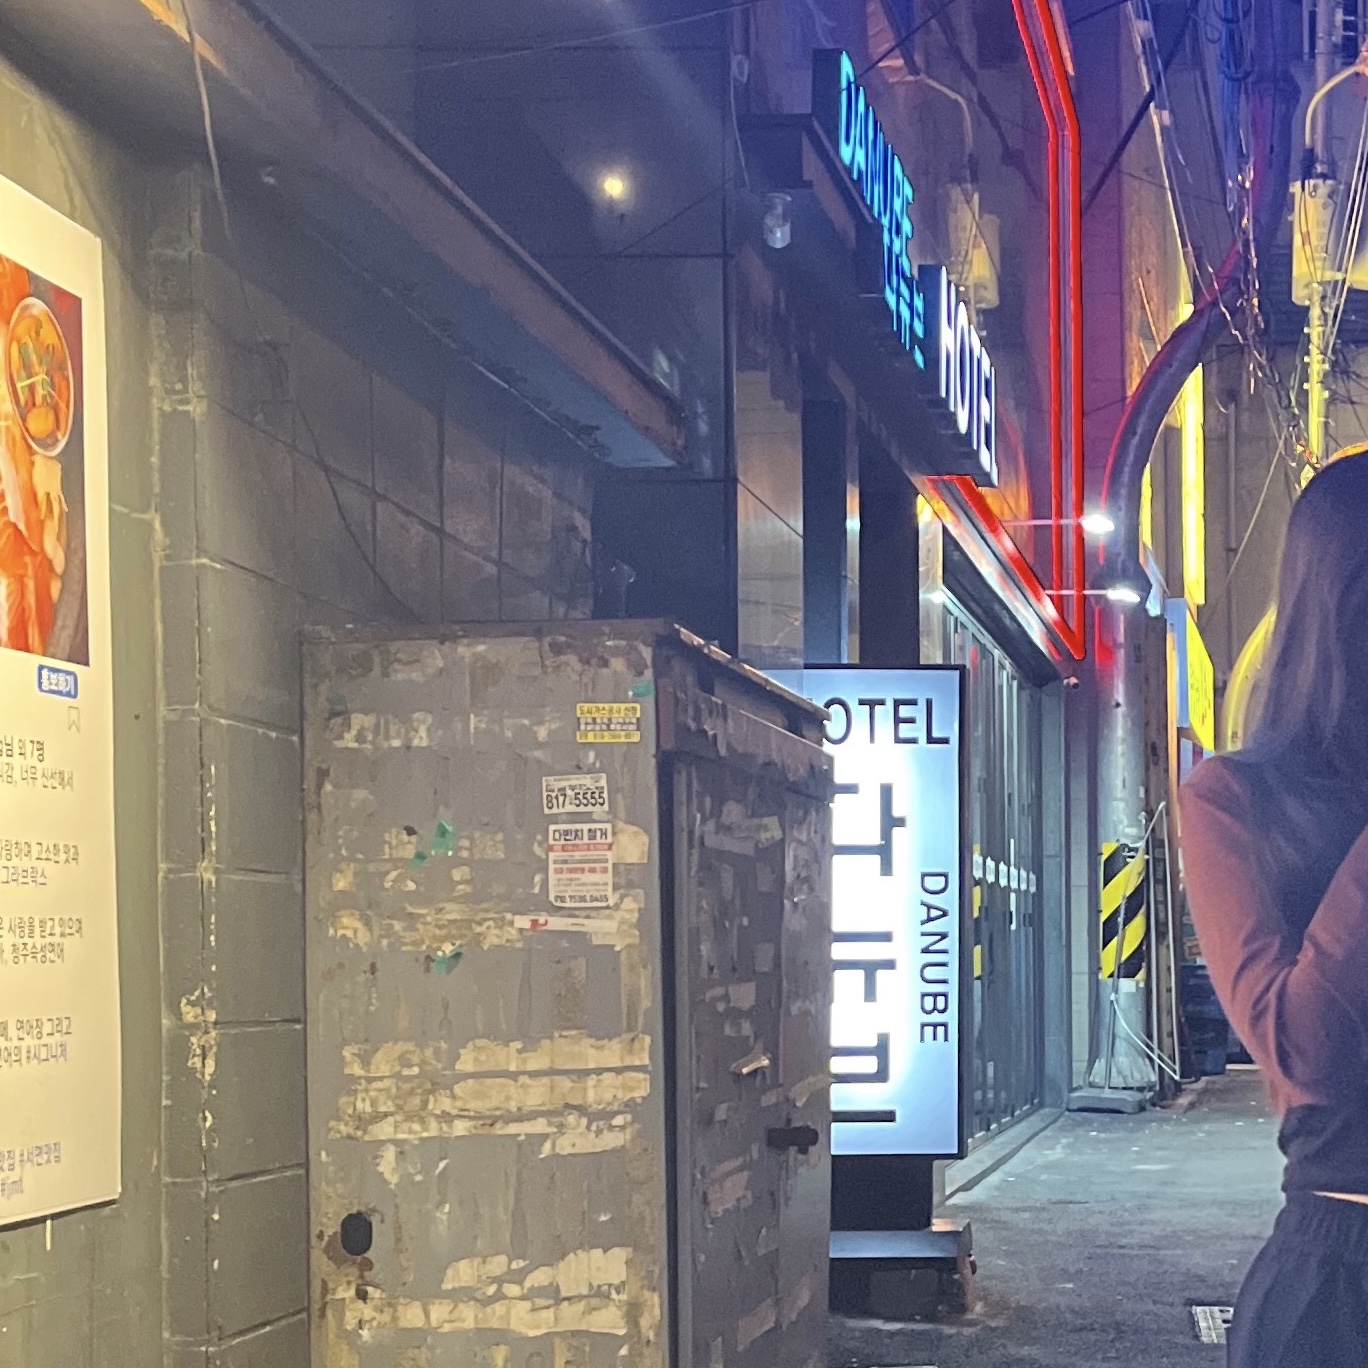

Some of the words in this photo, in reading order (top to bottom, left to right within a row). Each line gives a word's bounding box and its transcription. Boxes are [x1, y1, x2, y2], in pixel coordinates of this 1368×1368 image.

[839, 51, 914, 278] DANUBE
[938, 265, 998, 487] HOTEL
[808, 697, 951, 746] OTEL
[29, 739, 45, 763] 7명
[21, 765, 39, 789] 너무
[546, 793, 566, 810] 817
[574, 790, 606, 808] 5555
[0, 839, 32, 862] 랑하며
[8, 916, 36, 939] 사랑을
[919, 871, 950, 1043] DANUBE
[16, 1017, 44, 1042] 연어장
[46, 1015, 73, 1038] 그리고
[0, 1045, 22, 1069] 어의
